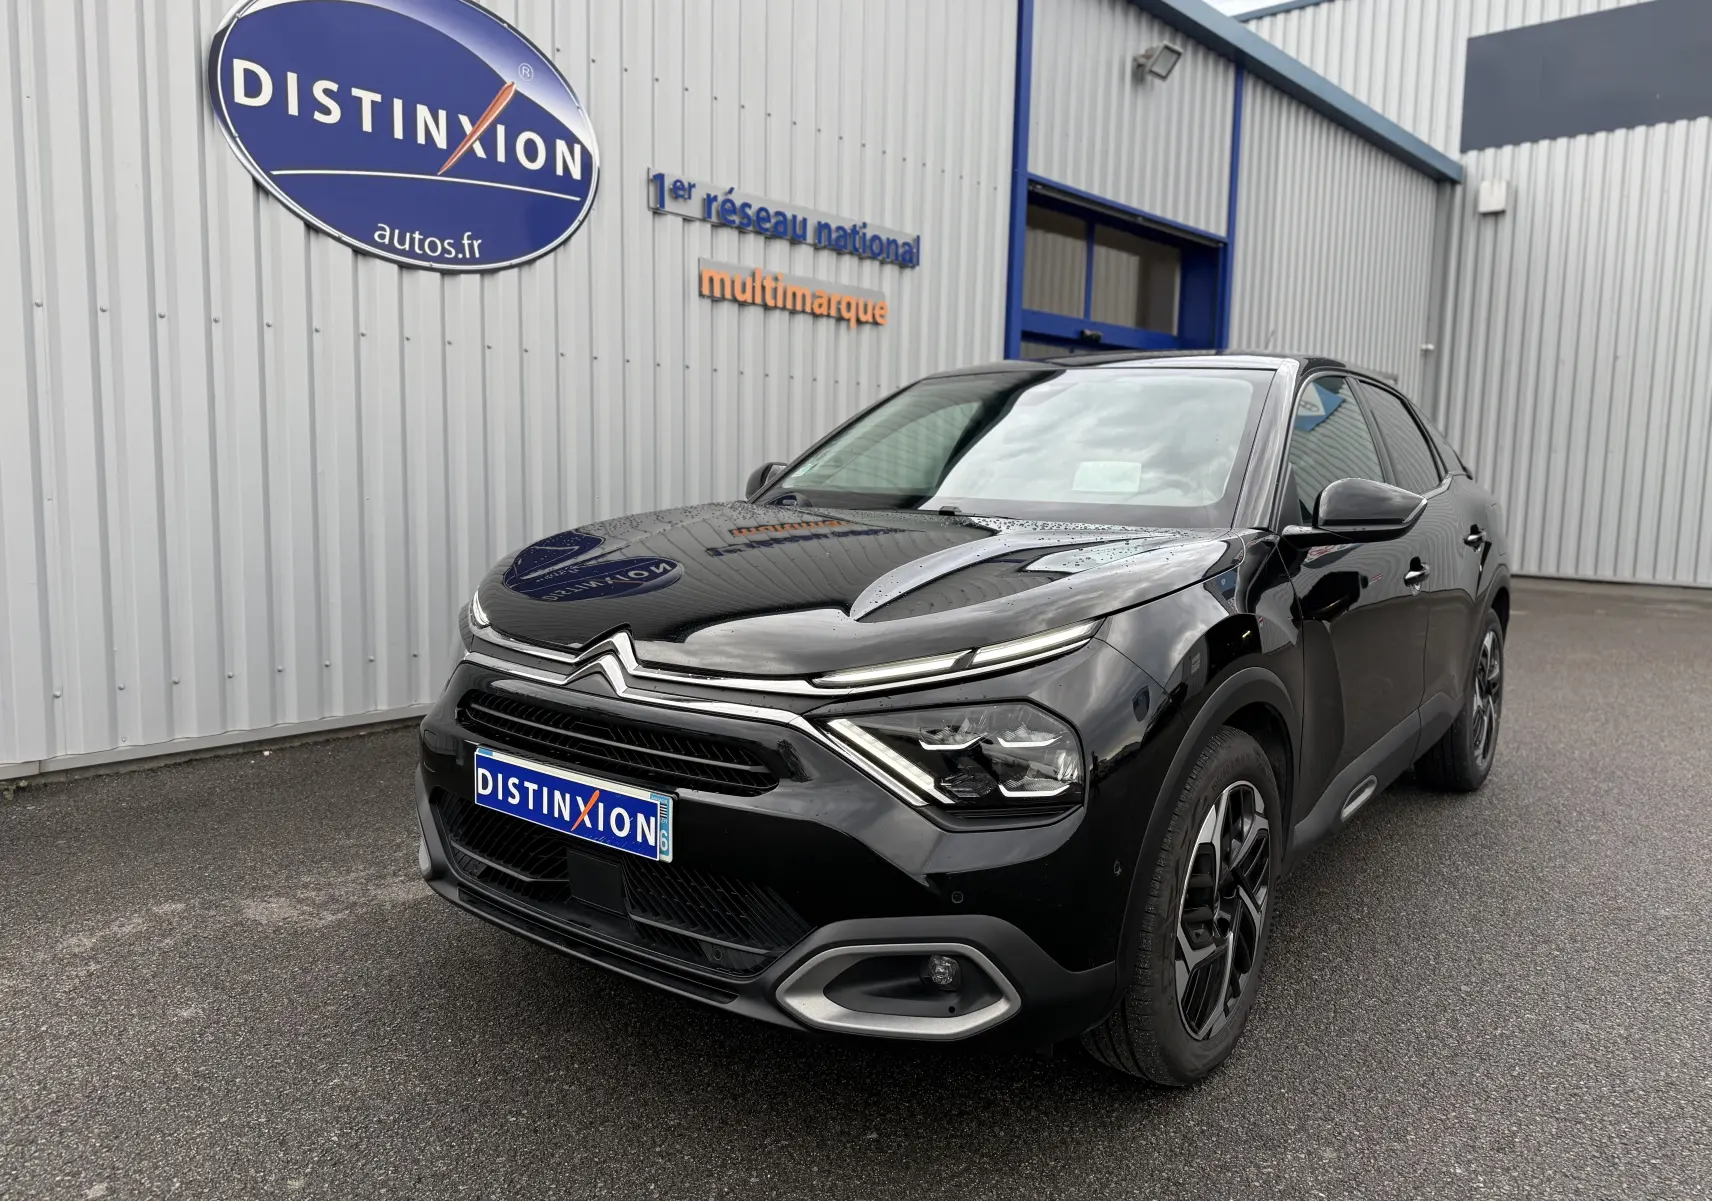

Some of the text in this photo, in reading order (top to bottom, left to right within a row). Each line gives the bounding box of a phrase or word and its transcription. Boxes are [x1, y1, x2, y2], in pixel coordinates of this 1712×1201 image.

[232, 58, 583, 181] DISTINXION
[373, 223, 482, 259] autos.fr
[652, 172, 921, 267] 1er réseau national
[700, 267, 889, 329] multimarque
[477, 767, 656, 847] DISTINXION
